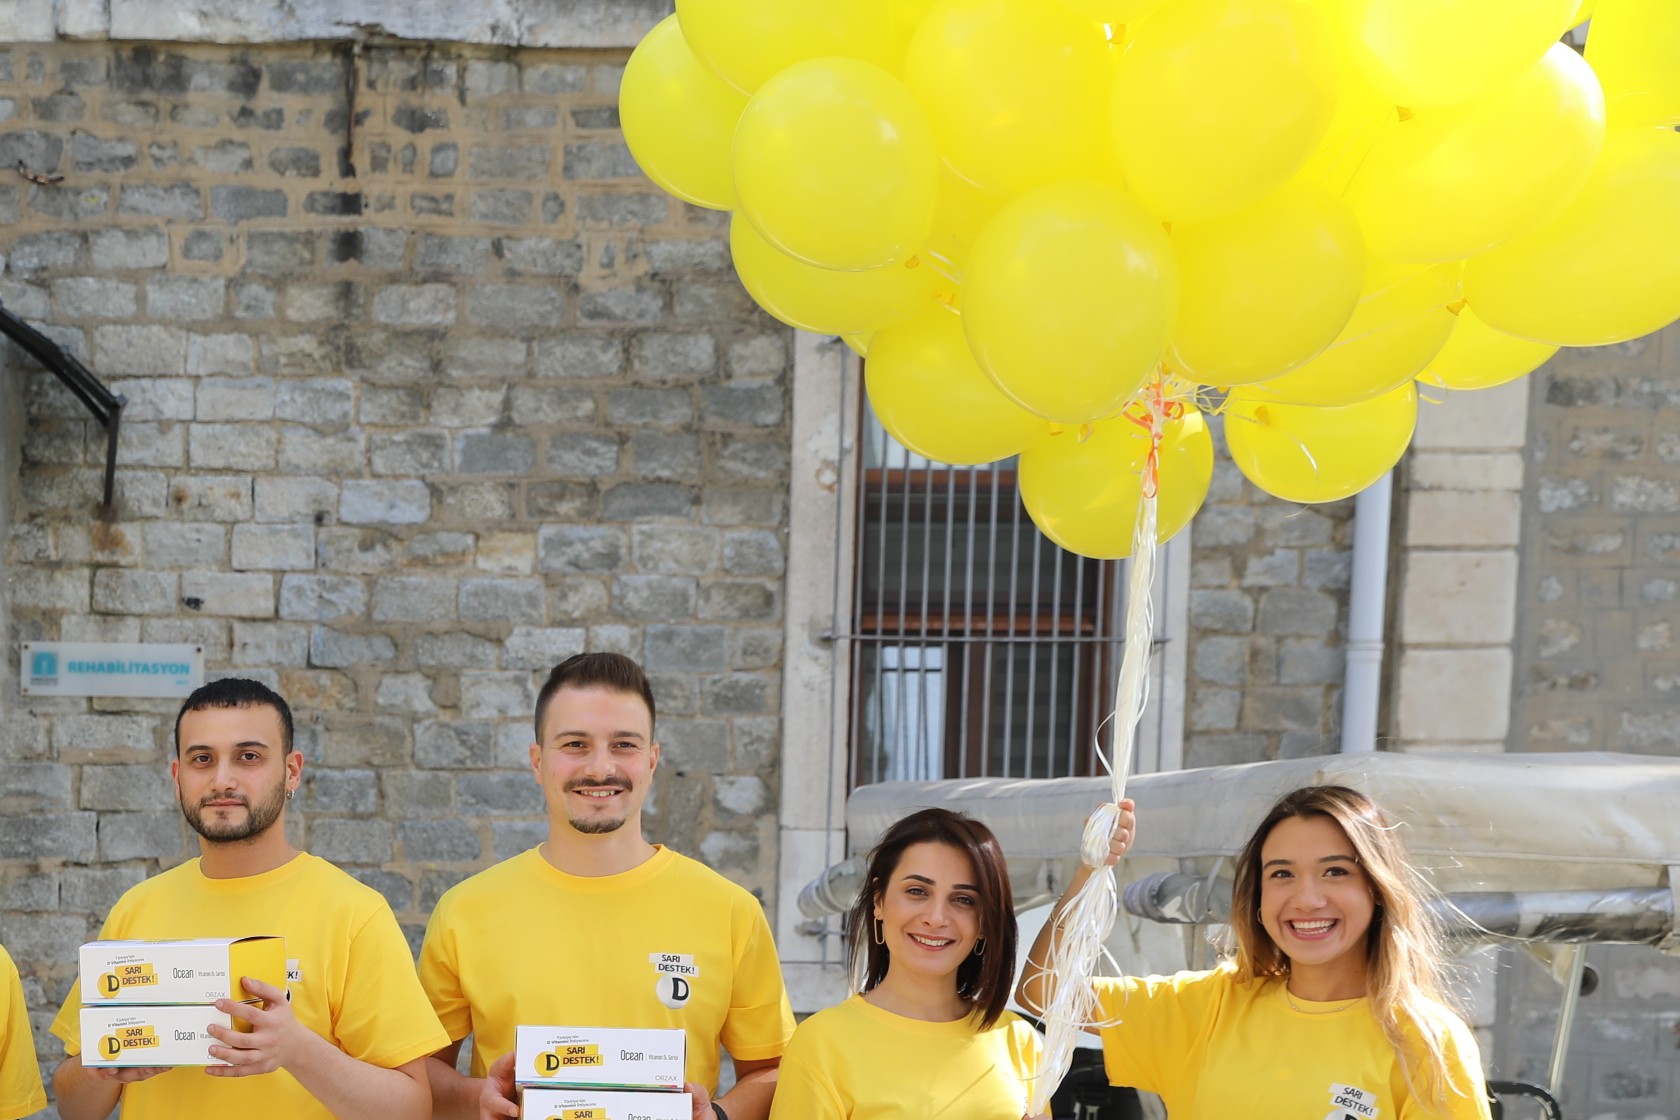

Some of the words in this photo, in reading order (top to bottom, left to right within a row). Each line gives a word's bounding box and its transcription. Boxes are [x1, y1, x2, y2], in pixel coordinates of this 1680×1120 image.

[68, 660, 189, 674] REHABİLİTASYON
[125, 966, 141, 974] SARI
[173, 968, 193, 978] Ocean
[659, 964, 694, 974] DESTEK!
[107, 975, 119, 992] D
[123, 975, 154, 985] DESTEK!
[672, 978, 689, 1000] D
[126, 1028, 142, 1037] SARI
[175, 1030, 195, 1040] Ocean
[108, 1037, 120, 1054] D
[124, 1038, 155, 1047] DESTEK!
[563, 1056, 598, 1064] DESTEK!
[621, 1050, 643, 1060] Ocean
[546, 1054, 559, 1071] D
[1343, 1087, 1363, 1099] SARI
[1335, 1096, 1373, 1116] DESTEK!
